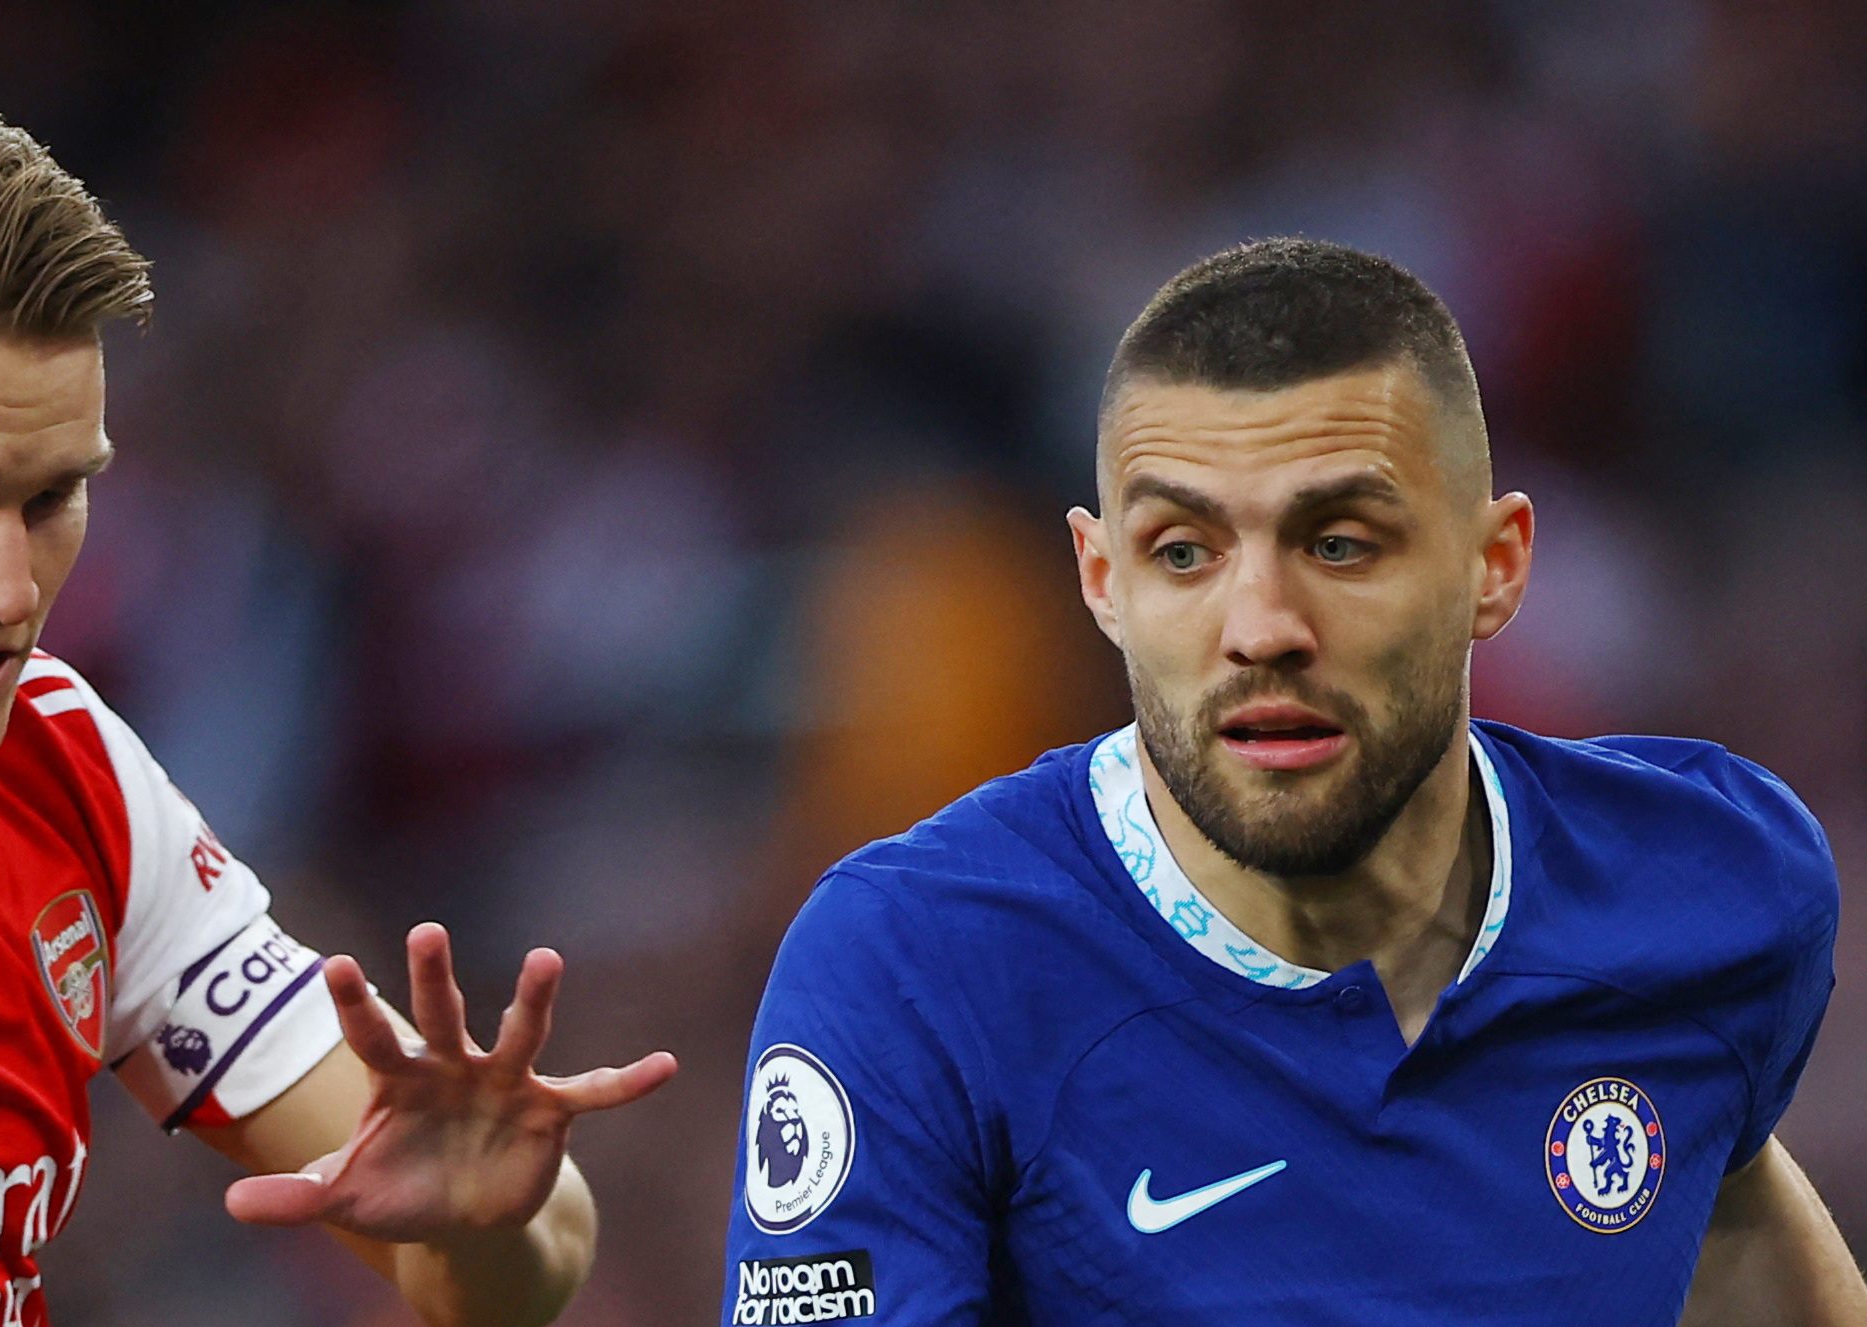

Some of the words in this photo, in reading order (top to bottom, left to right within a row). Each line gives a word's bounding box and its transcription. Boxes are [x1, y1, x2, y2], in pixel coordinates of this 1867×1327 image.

[1564, 1083, 1639, 1122] CHELSEA
[775, 1185, 813, 1214] Premier
[810, 1131, 833, 1187] League
[1576, 1203, 1626, 1225] FOOTBALL
[1629, 1188, 1651, 1215] CLUB
[739, 1261, 770, 1294] No
[771, 1260, 855, 1294] room
[733, 1294, 770, 1326] for
[771, 1288, 874, 1324] racism
